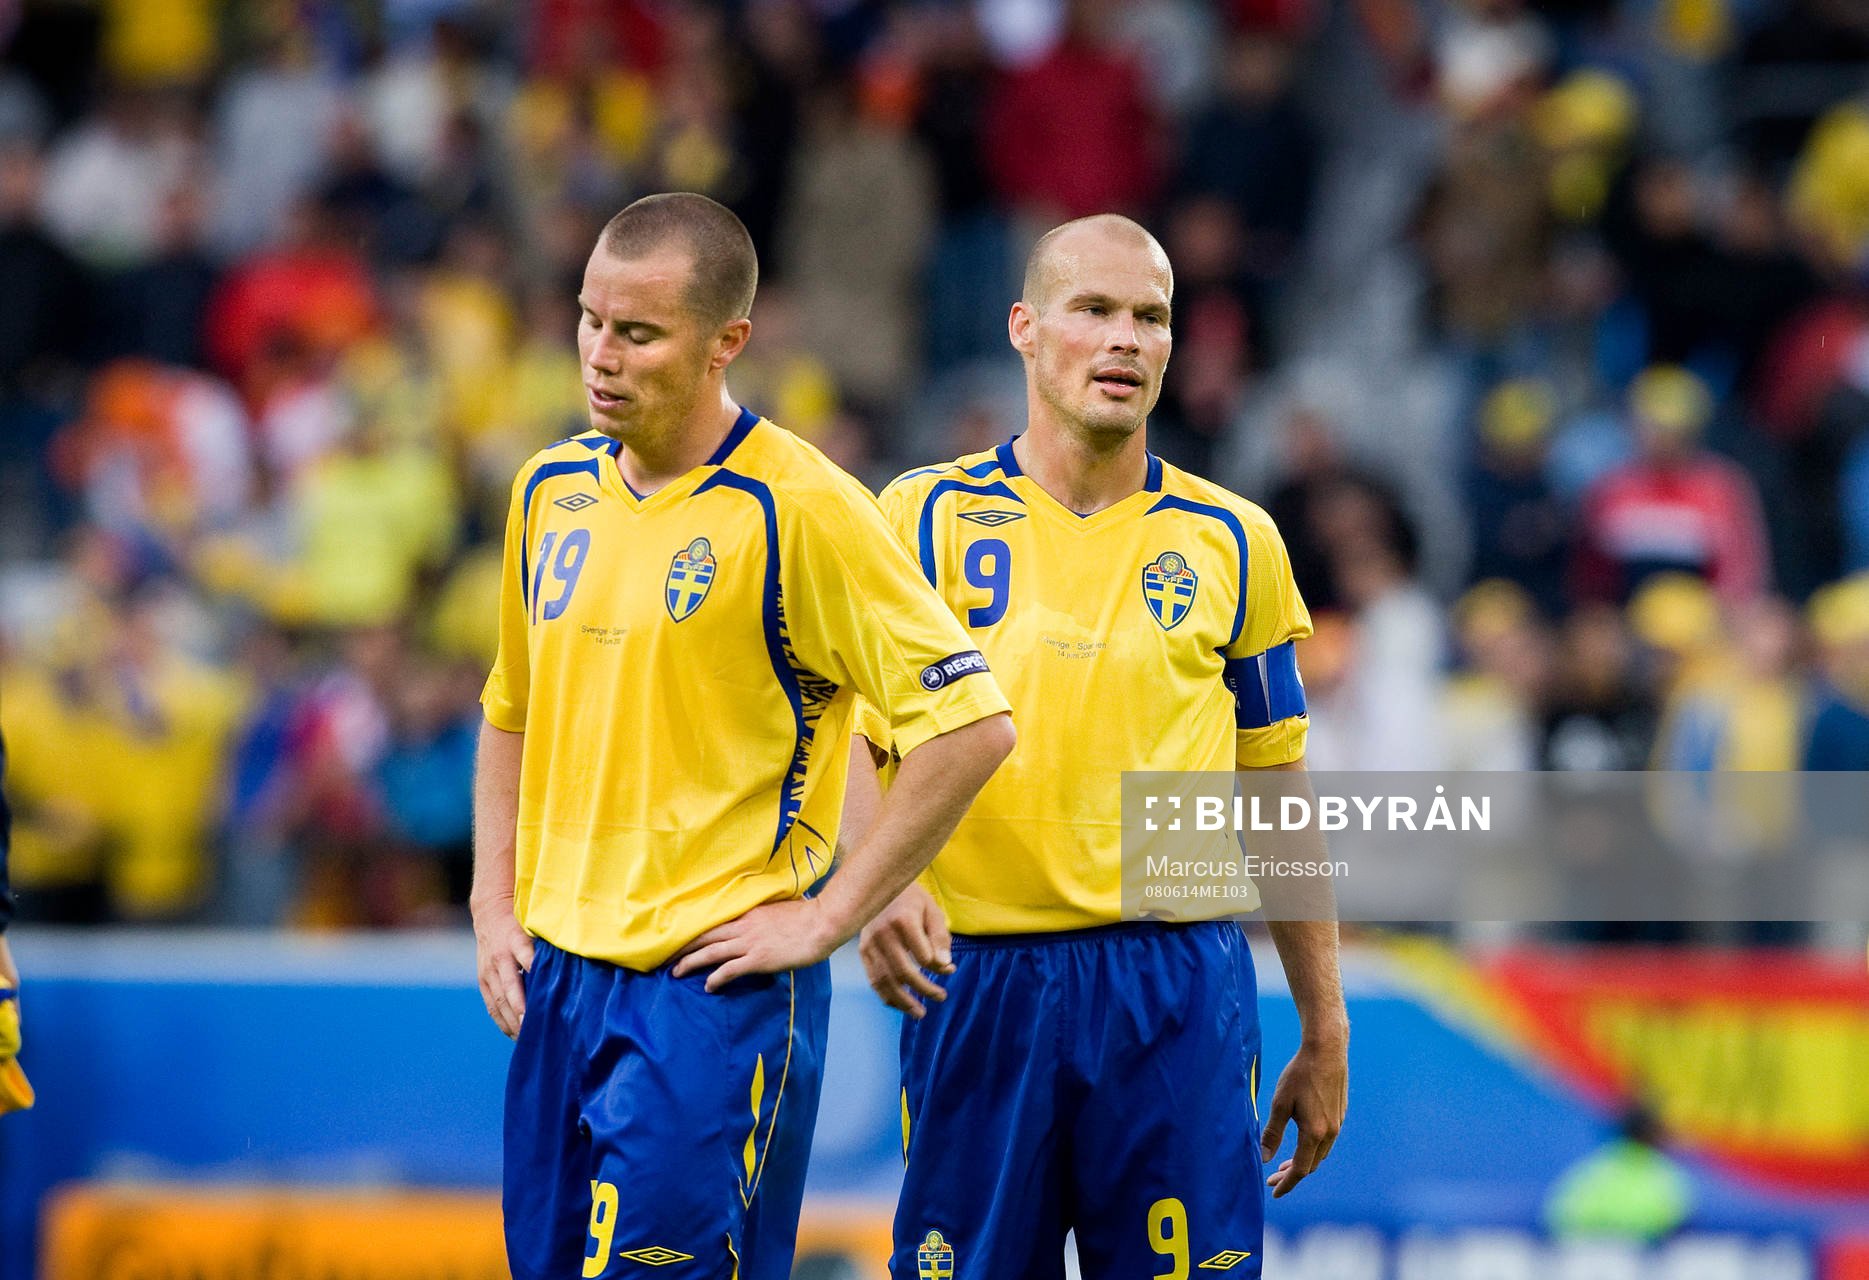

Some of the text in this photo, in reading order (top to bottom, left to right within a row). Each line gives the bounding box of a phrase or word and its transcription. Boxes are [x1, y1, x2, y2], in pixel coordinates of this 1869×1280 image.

[532, 529, 591, 625] 19
[964, 538, 1011, 628] 9
[1147, 1197, 1189, 1280] 9
